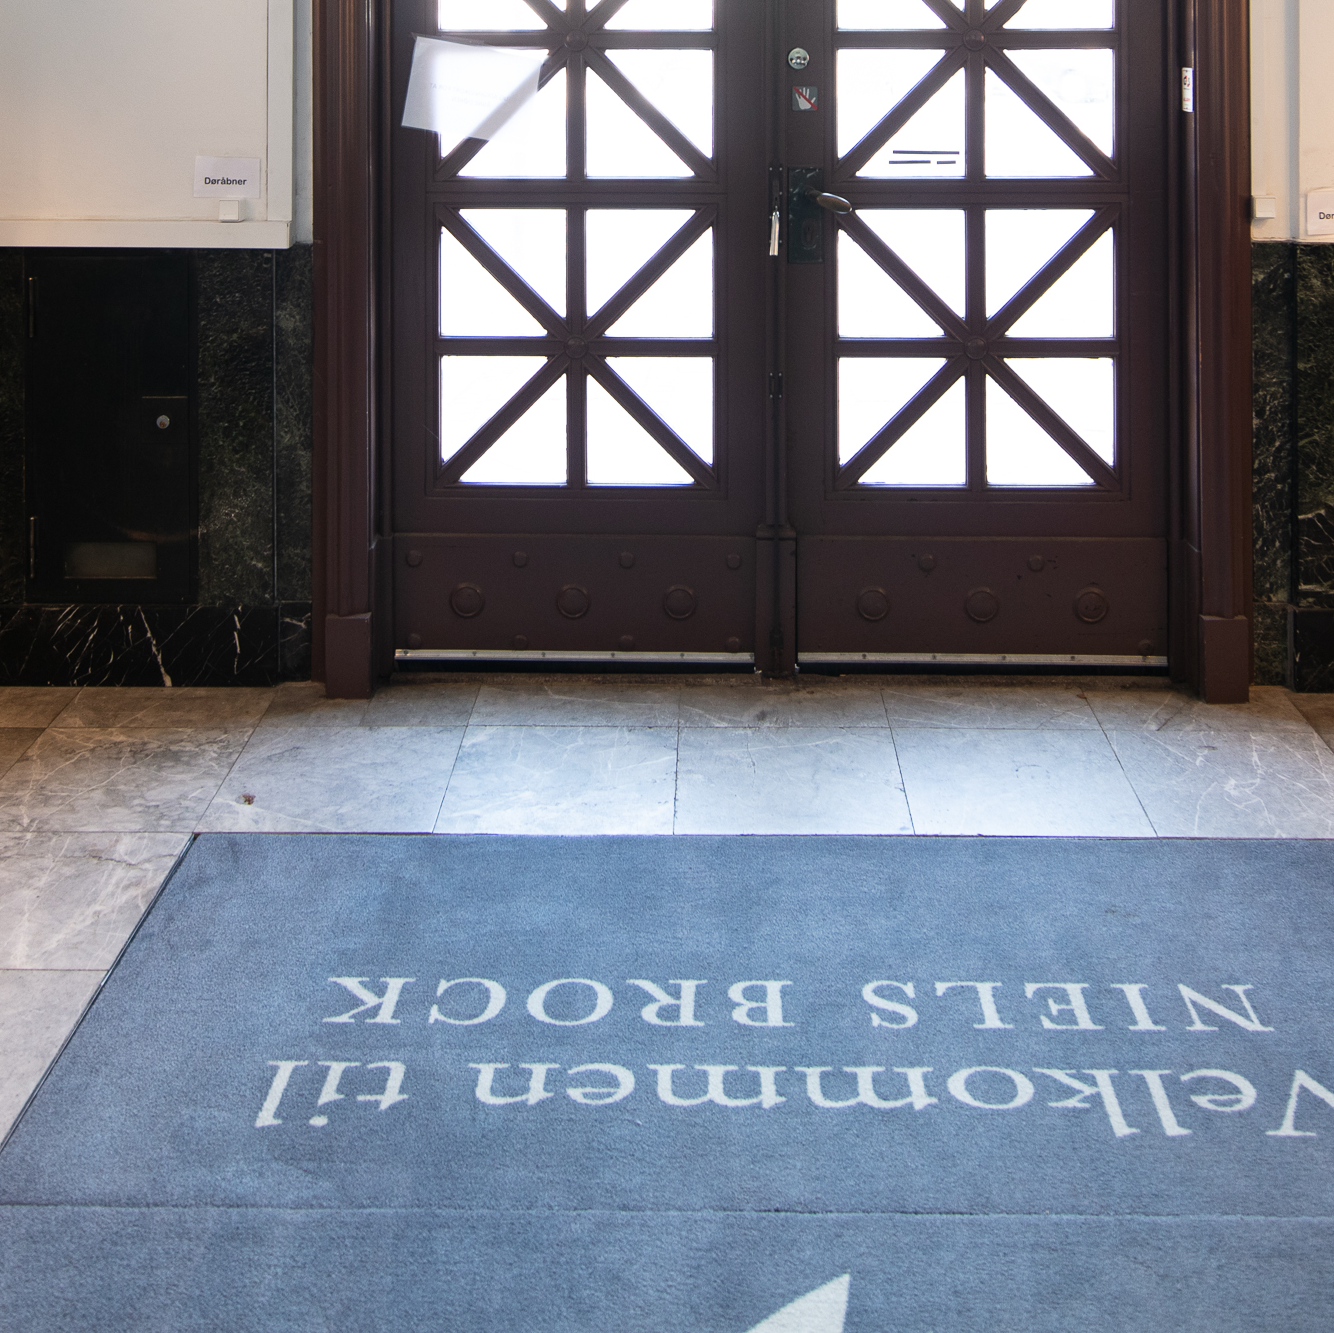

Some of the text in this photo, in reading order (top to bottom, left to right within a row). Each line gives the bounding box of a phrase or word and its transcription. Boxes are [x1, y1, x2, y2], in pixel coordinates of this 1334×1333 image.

[204, 176, 247, 185] Døråbner
[322, 977, 1275, 1032] NIELS BROCK
[255, 1060, 409, 1127] til
